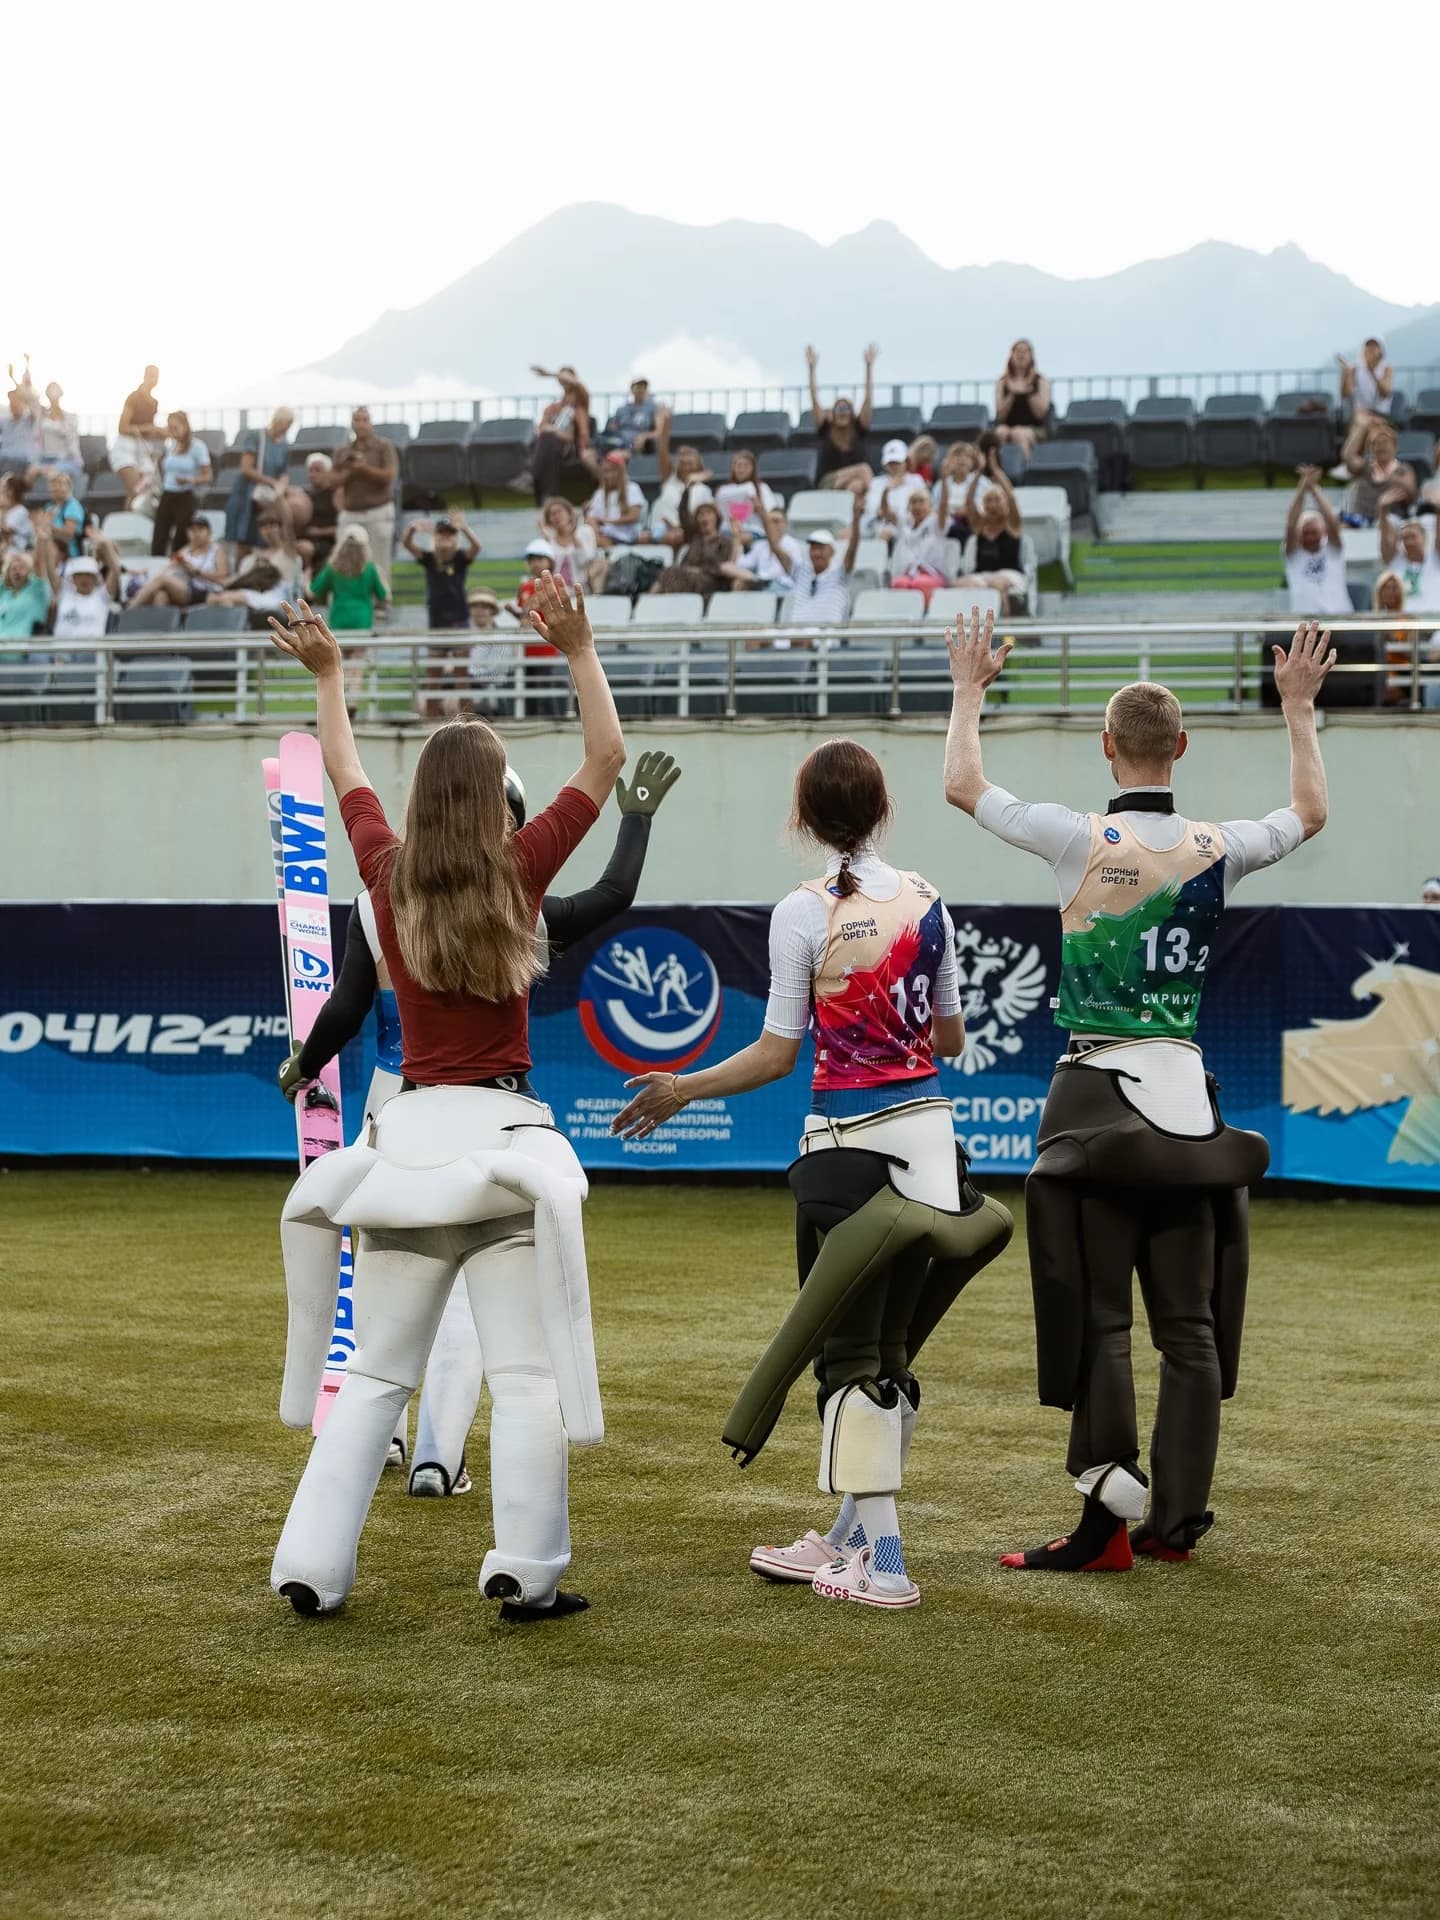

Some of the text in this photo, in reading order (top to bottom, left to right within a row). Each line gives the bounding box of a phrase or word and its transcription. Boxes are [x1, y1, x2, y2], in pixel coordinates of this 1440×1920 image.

[281, 794, 328, 895] BWT
[1101, 867, 1139, 877] ГОРНЫЙ
[841, 918, 876, 931] ГОРНЫЙ
[293, 979, 331, 992] BWT
[890, 974, 931, 1024] 13
[952, 1096, 1047, 1122] СПОРТ
[566, 1112, 586, 1124] НА
[666, 1114, 733, 1125] АМПЛИНА
[570, 1127, 580, 1137] И
[652, 1128, 731, 1140] ДВОЕБОРЬЯ
[622, 1141, 677, 1153] РОССИИ
[955, 1133, 1033, 1160] СИИ
[814, 1580, 850, 1599] crocs
